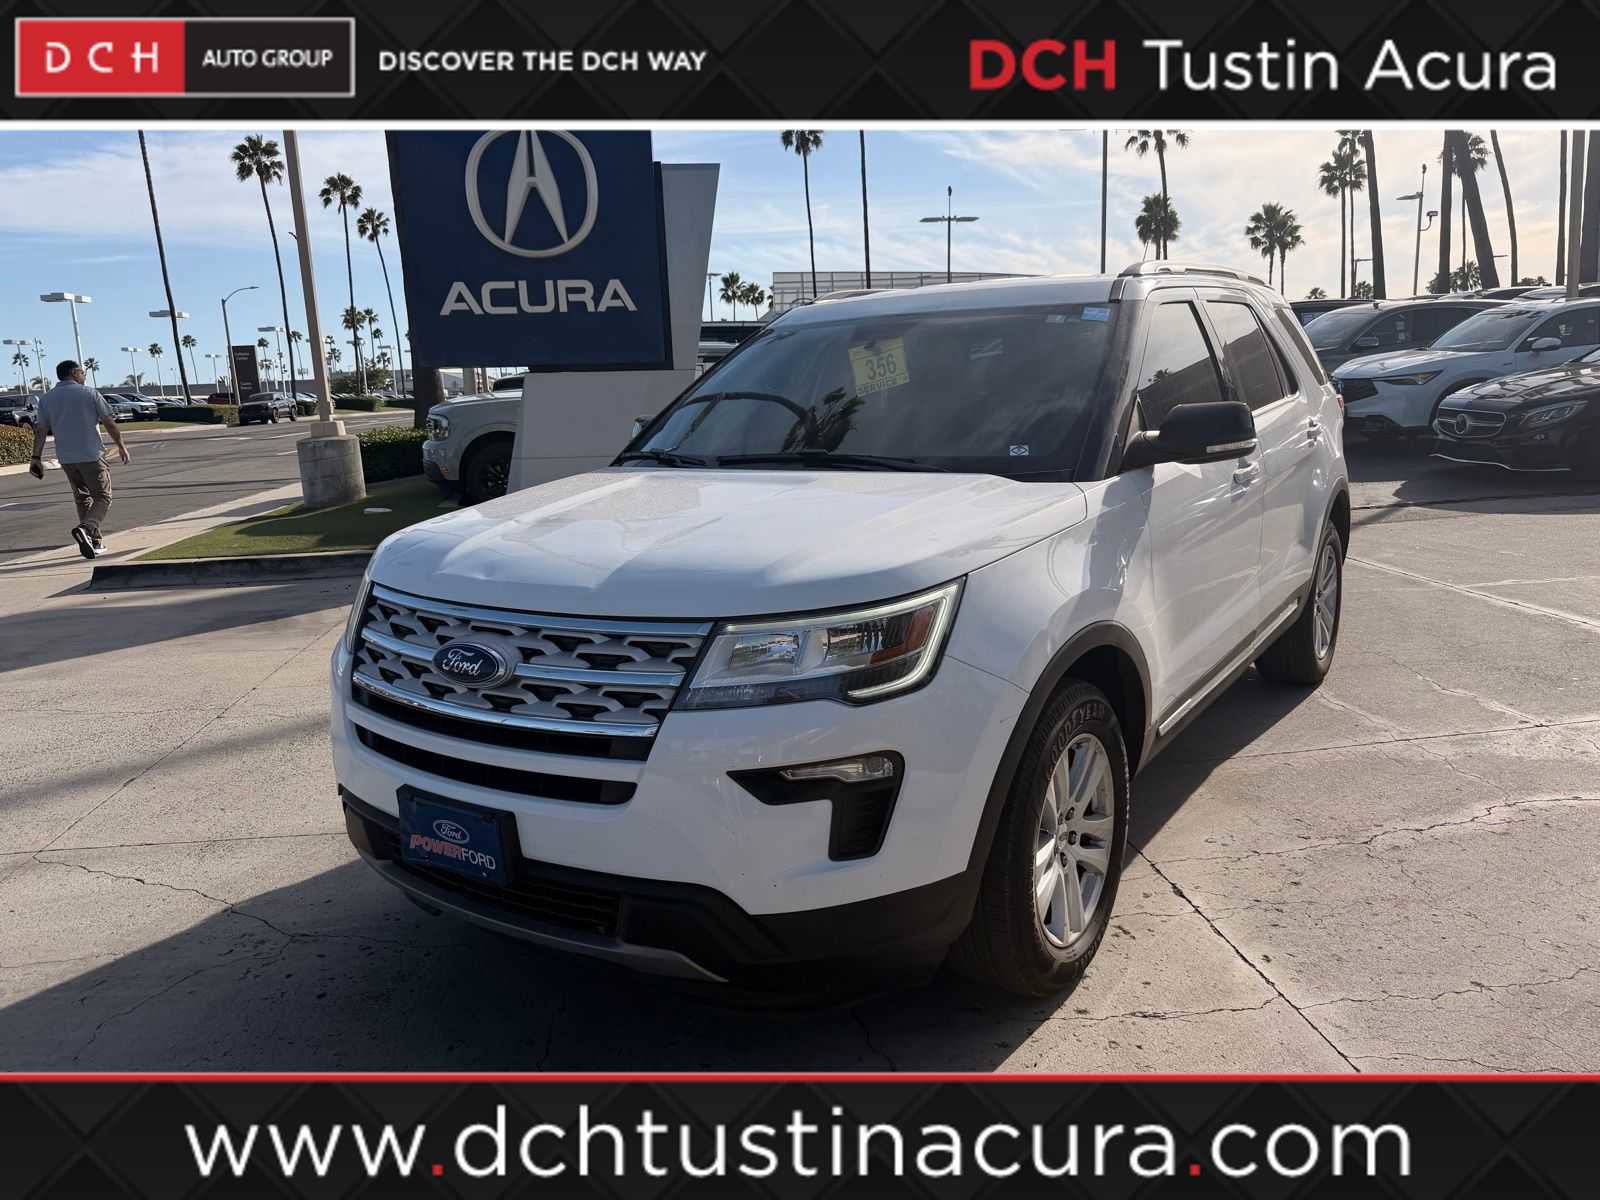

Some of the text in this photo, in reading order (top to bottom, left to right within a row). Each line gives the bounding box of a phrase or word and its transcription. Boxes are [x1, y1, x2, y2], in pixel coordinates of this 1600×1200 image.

[439, 279, 638, 316] ACURA
[865, 353, 897, 380] 356
[442, 648, 483, 676] Ford
[440, 823, 463, 841] Ford
